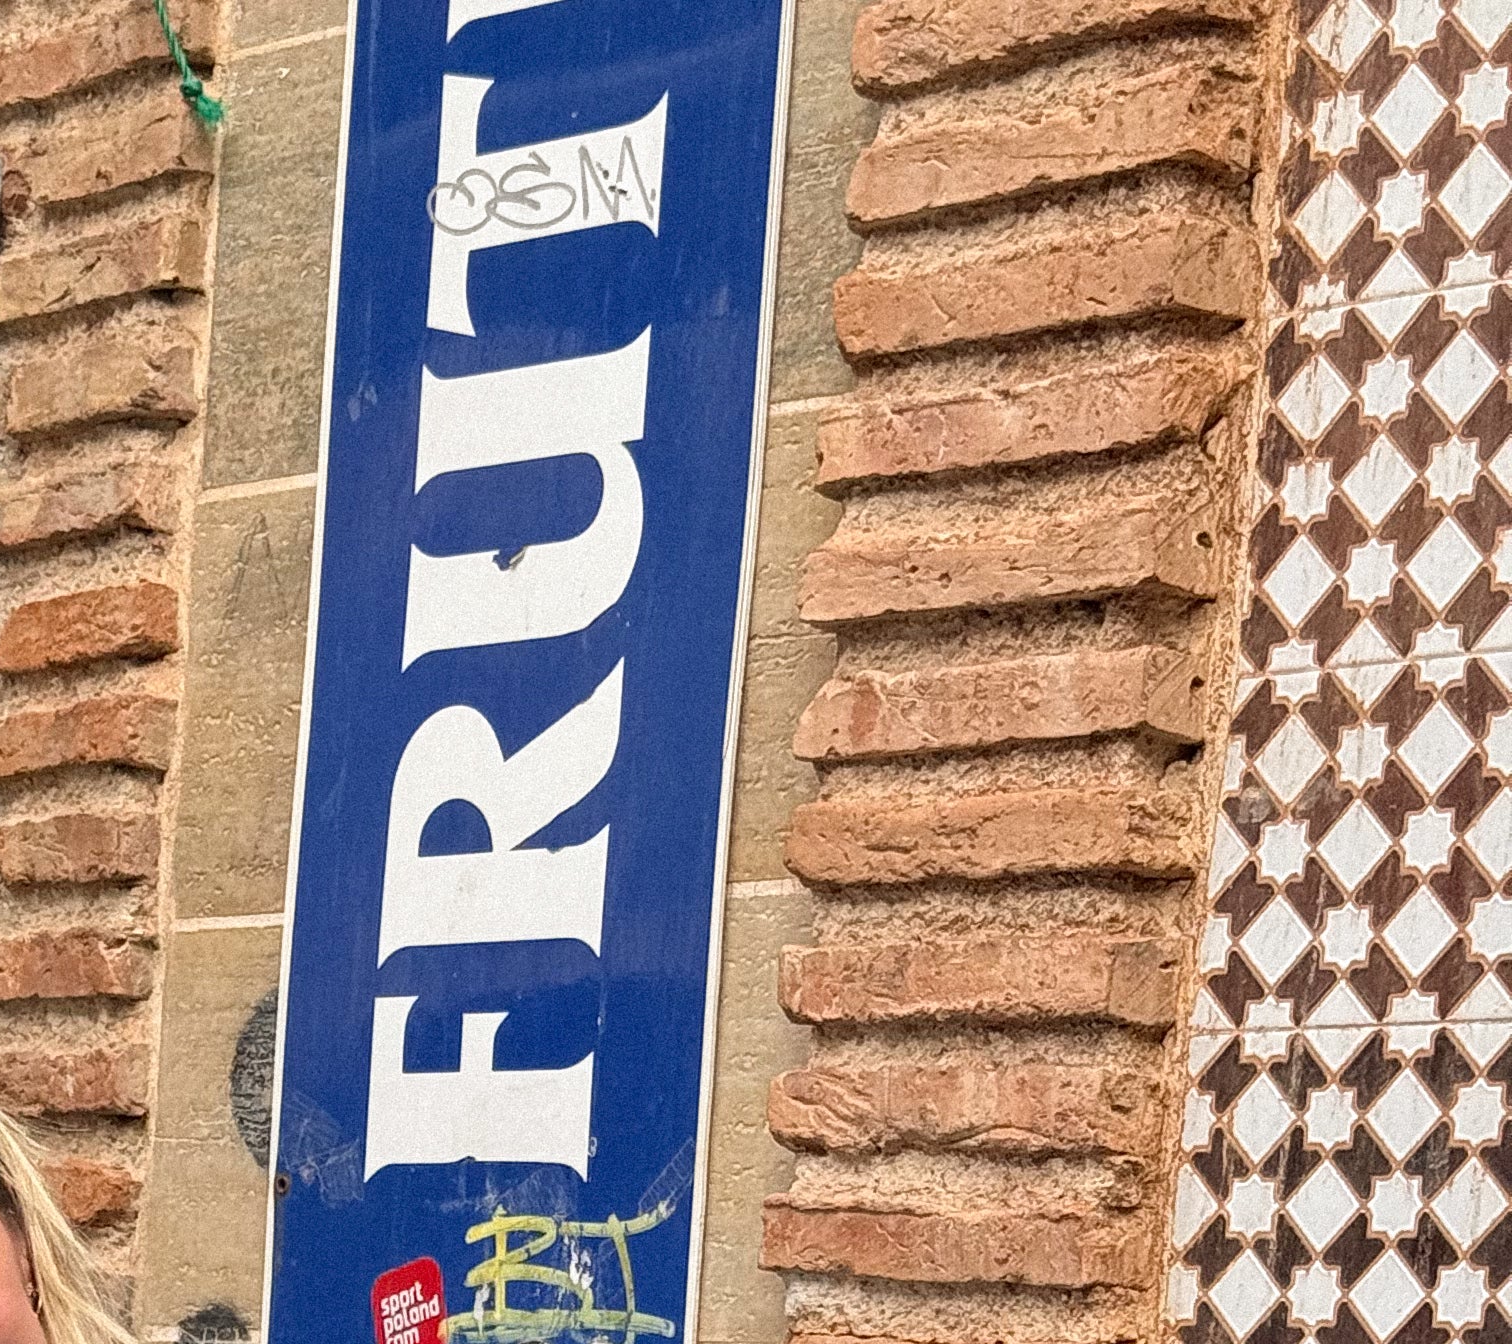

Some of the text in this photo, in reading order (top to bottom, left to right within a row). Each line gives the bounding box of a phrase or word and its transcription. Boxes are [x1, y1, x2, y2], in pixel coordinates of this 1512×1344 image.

[363, 0, 668, 1183] FRUT
[381, 1281, 424, 1317] sport
[383, 1294, 440, 1340] poland
